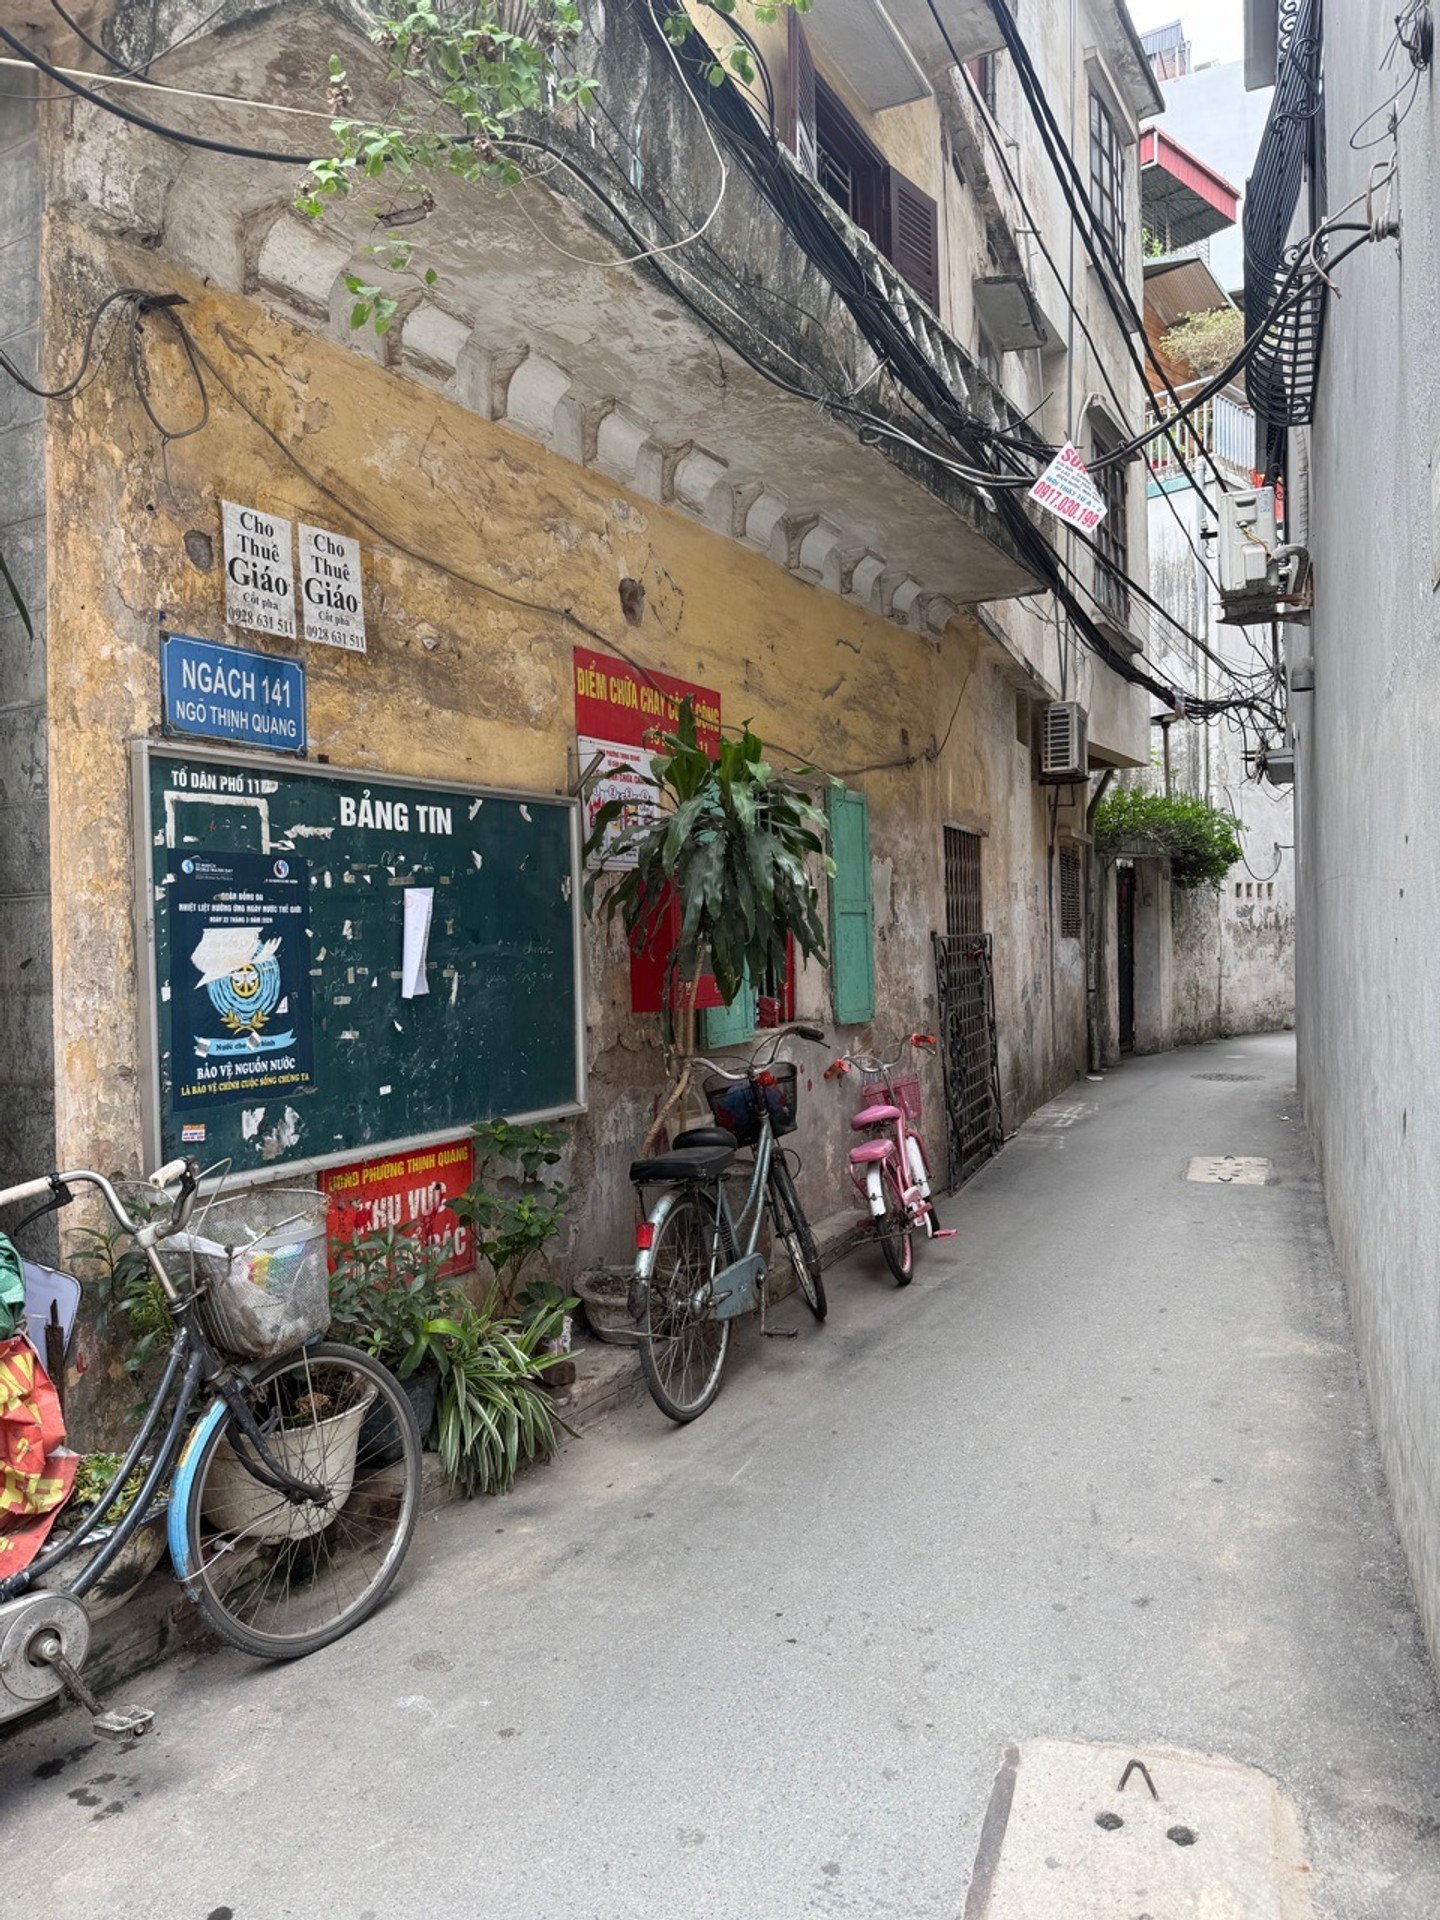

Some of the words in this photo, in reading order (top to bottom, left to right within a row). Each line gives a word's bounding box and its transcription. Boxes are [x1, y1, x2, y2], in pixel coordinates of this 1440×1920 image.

[1033, 481, 1100, 529] 0917.030.199
[240, 511, 274, 537] Cho
[237, 534, 280, 563] Thuê
[314, 533, 345, 558] Cho
[228, 556, 288, 597] Giáo
[311, 555, 350, 581] Thuê
[304, 577, 358, 613] Giáo
[228, 606, 254, 625] 0928
[256, 613, 274, 629] 631
[277, 618, 293, 634] 511
[305, 624, 330, 641] 0928
[331, 630, 347, 645] 631
[349, 634, 365, 649] 511
[182, 658, 255, 702] NGÁCH
[262, 675, 290, 709] 141
[576, 660, 608, 702] ĐIỂM
[609, 675, 639, 710] CHỮA
[176, 698, 207, 723] NGÕ
[209, 705, 249, 733] THỊNH
[252, 713, 297, 738] QUANG
[171, 765, 188, 787] TỔ
[190, 770, 217, 790] DÂN
[219, 773, 244, 793] PHỐ
[340, 789, 409, 832] BẢNG
[415, 804, 452, 835] TIN
[196, 1062, 218, 1080] BẢO
[220, 1061, 234, 1080] VỆ
[235, 1056, 268, 1076] NGUỒN
[191, 1082, 207, 1095] BẢO
[300, 1072, 310, 1081] TA
[362, 1159, 405, 1185] PHƯỜNG
[407, 1153, 436, 1174] THỊNH
[437, 1146, 468, 1167] QUANG
